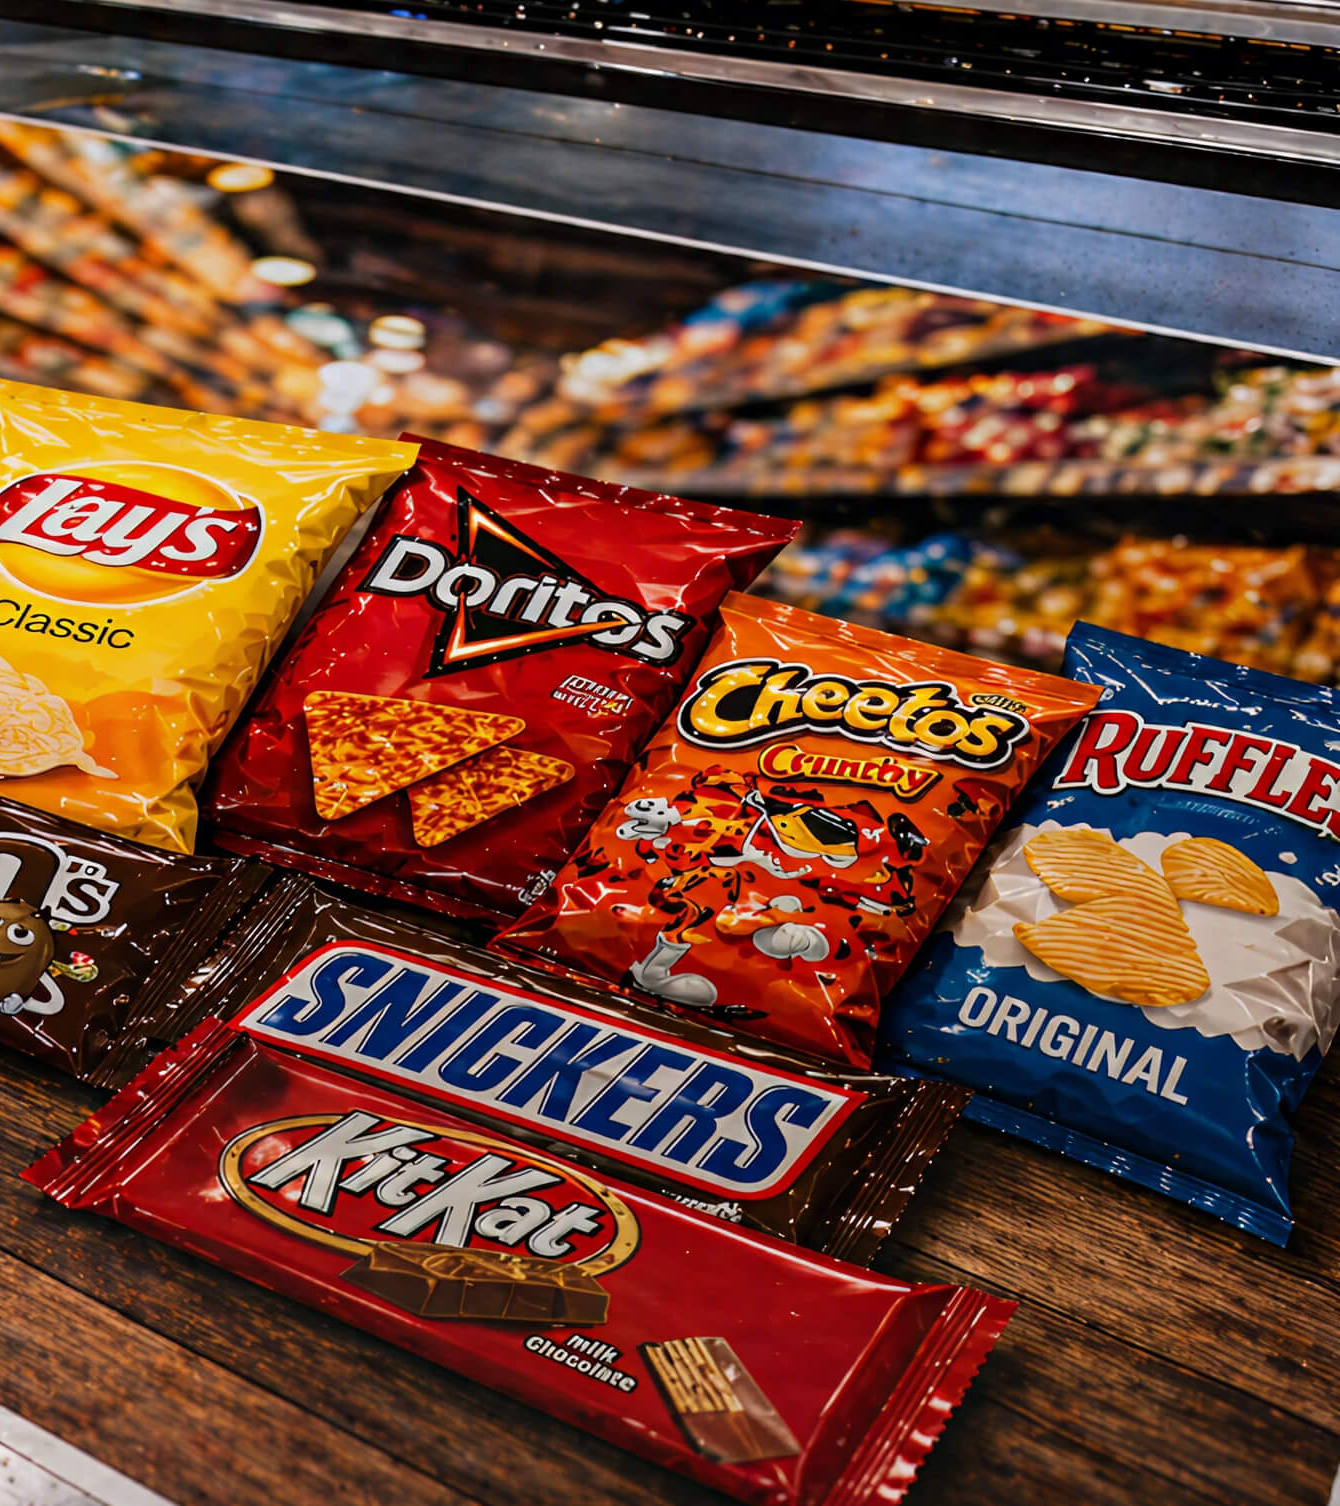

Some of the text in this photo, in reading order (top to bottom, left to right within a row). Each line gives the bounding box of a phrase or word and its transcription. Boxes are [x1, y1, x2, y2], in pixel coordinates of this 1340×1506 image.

[368, 538, 686, 661] Doritos
[687, 663, 1019, 759] Cheetos
[1057, 710, 1340, 839] RUFFLE
[260, 952, 833, 1186] SNICKERS
[958, 986, 1188, 1106] ORIGINAL
